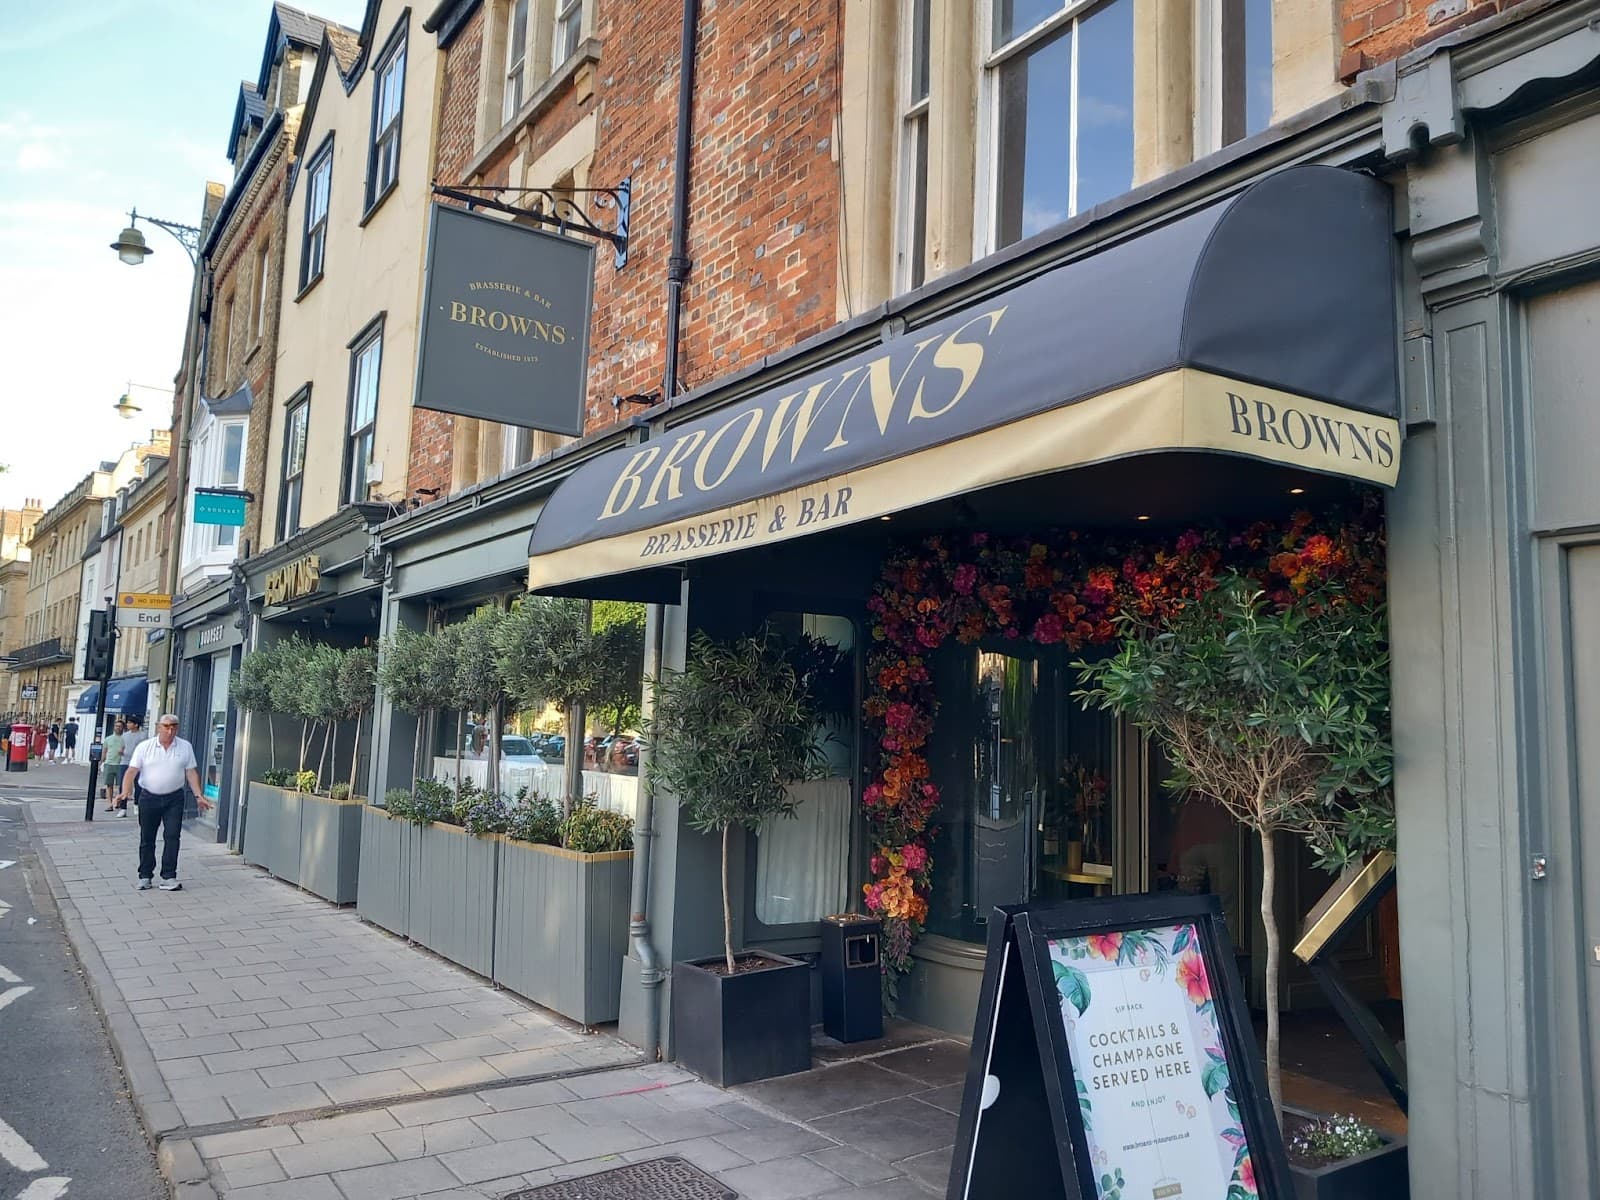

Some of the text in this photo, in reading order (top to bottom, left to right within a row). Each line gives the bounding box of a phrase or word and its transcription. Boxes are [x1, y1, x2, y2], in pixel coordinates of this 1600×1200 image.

[469, 281, 552, 309] BRASSERIE & BAR
[449, 300, 567, 345] BROWNS
[475, 342, 521, 361] ESTABLISHED
[597, 305, 1008, 521] BROWNS
[1225, 391, 1394, 468] BROWNS
[640, 486, 854, 558] BRASSERIE & BAR
[138, 612, 161, 623] End
[1127, 1003, 1144, 1011] BACK
[1089, 1022, 1179, 1048] COCKTAILS &
[1093, 1041, 1184, 1068] CHAMPAGNE
[1093, 1061, 1192, 1090] SERVED HERE
[1146, 1096, 1167, 1107] ENJOY
